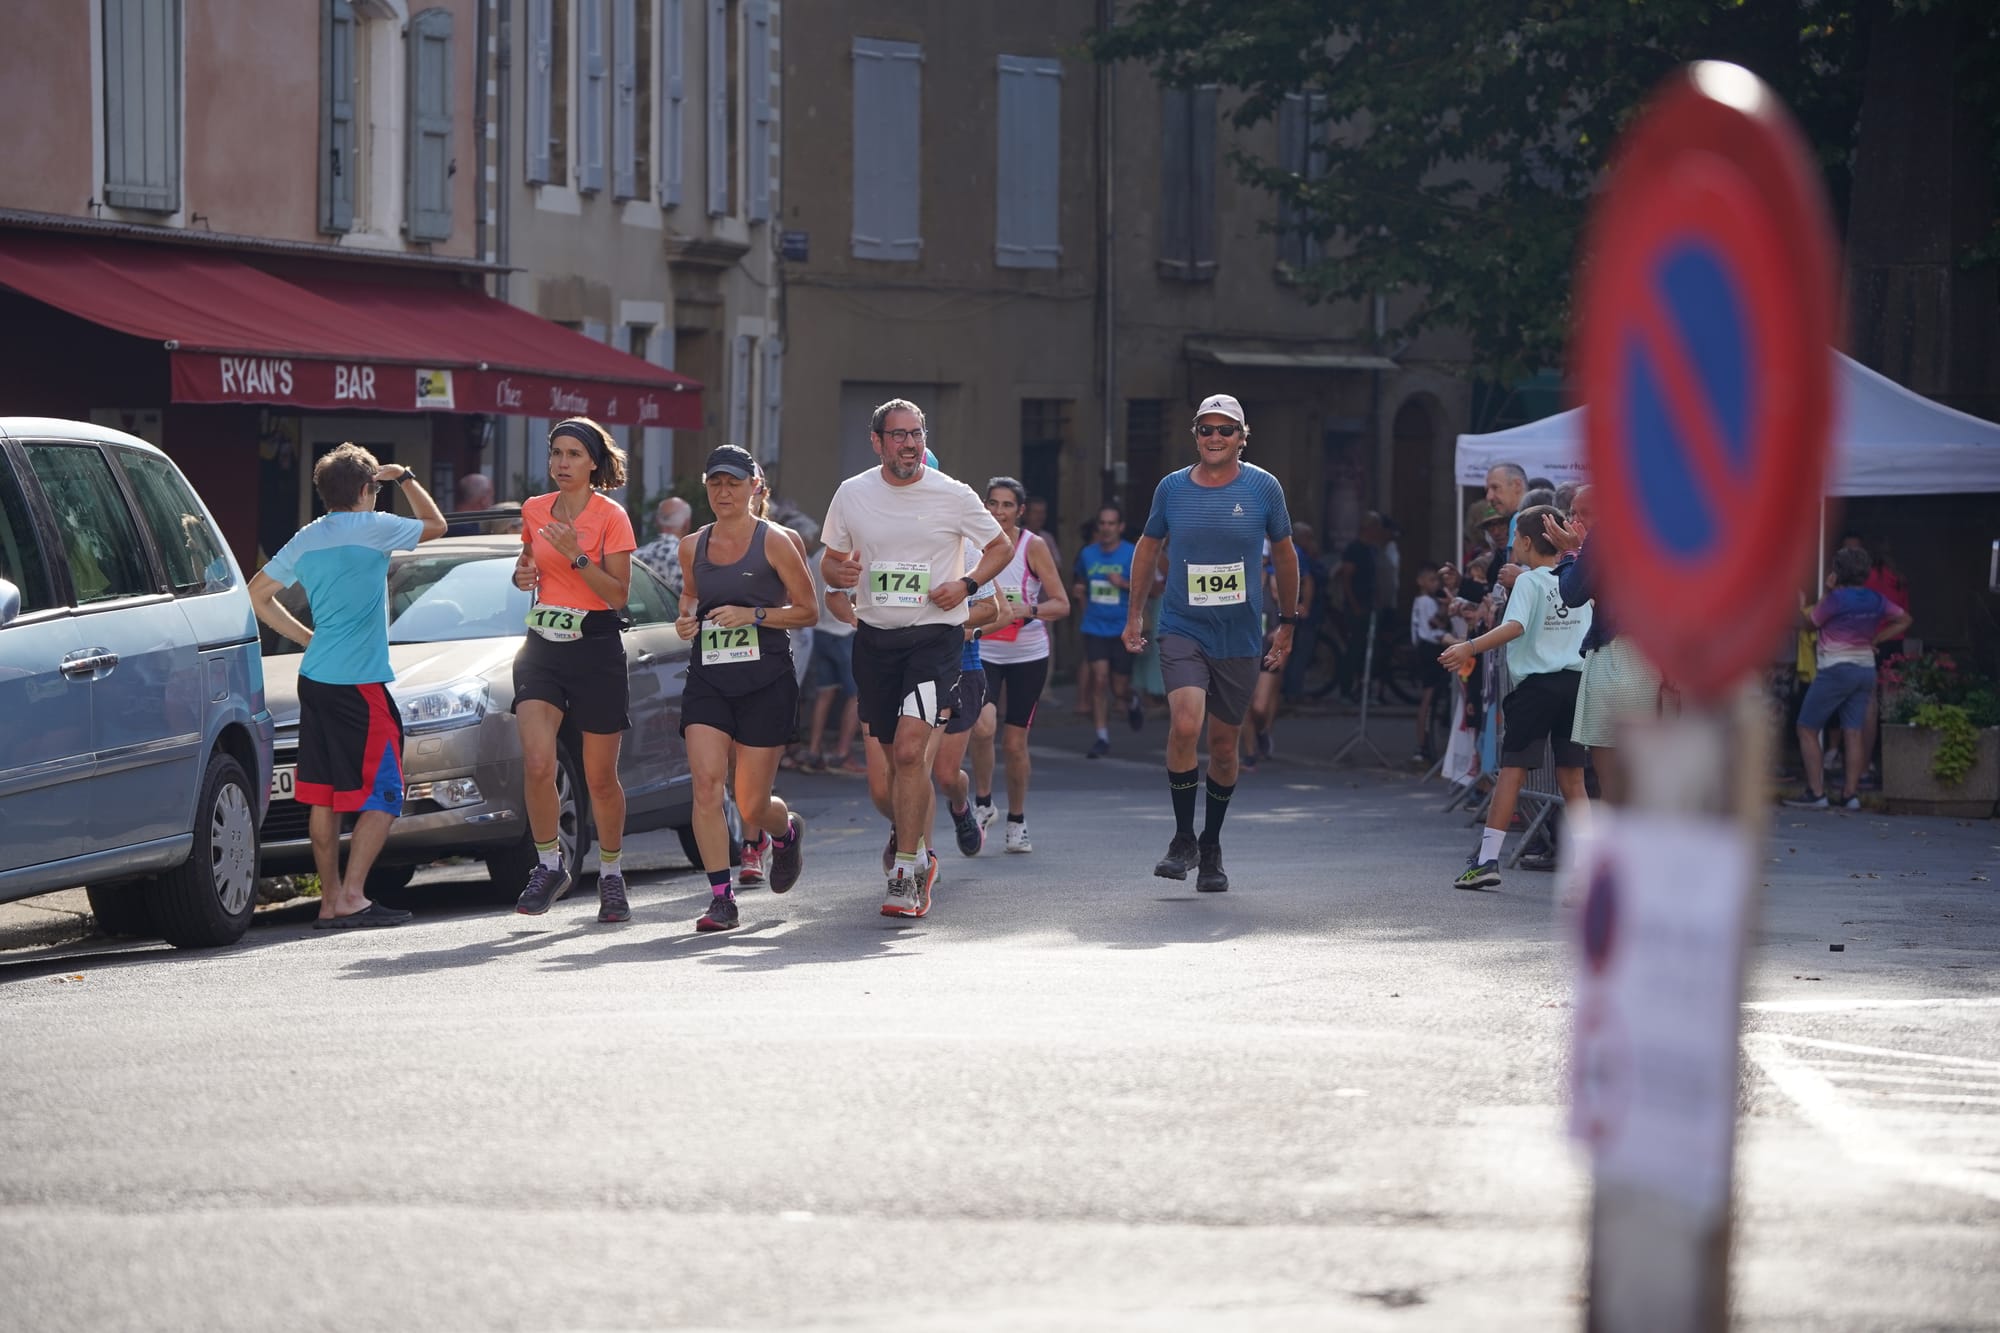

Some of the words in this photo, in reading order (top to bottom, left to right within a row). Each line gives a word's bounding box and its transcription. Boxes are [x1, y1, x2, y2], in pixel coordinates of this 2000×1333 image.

[220, 357, 293, 396] RYAN'S
[335, 365, 376, 399] BAR
[496, 377, 522, 407] Chez
[607, 396, 617, 416] et
[878, 573, 921, 592] 174
[1196, 574, 1238, 592] 194
[534, 610, 574, 630] 173
[708, 628, 749, 649] 172
